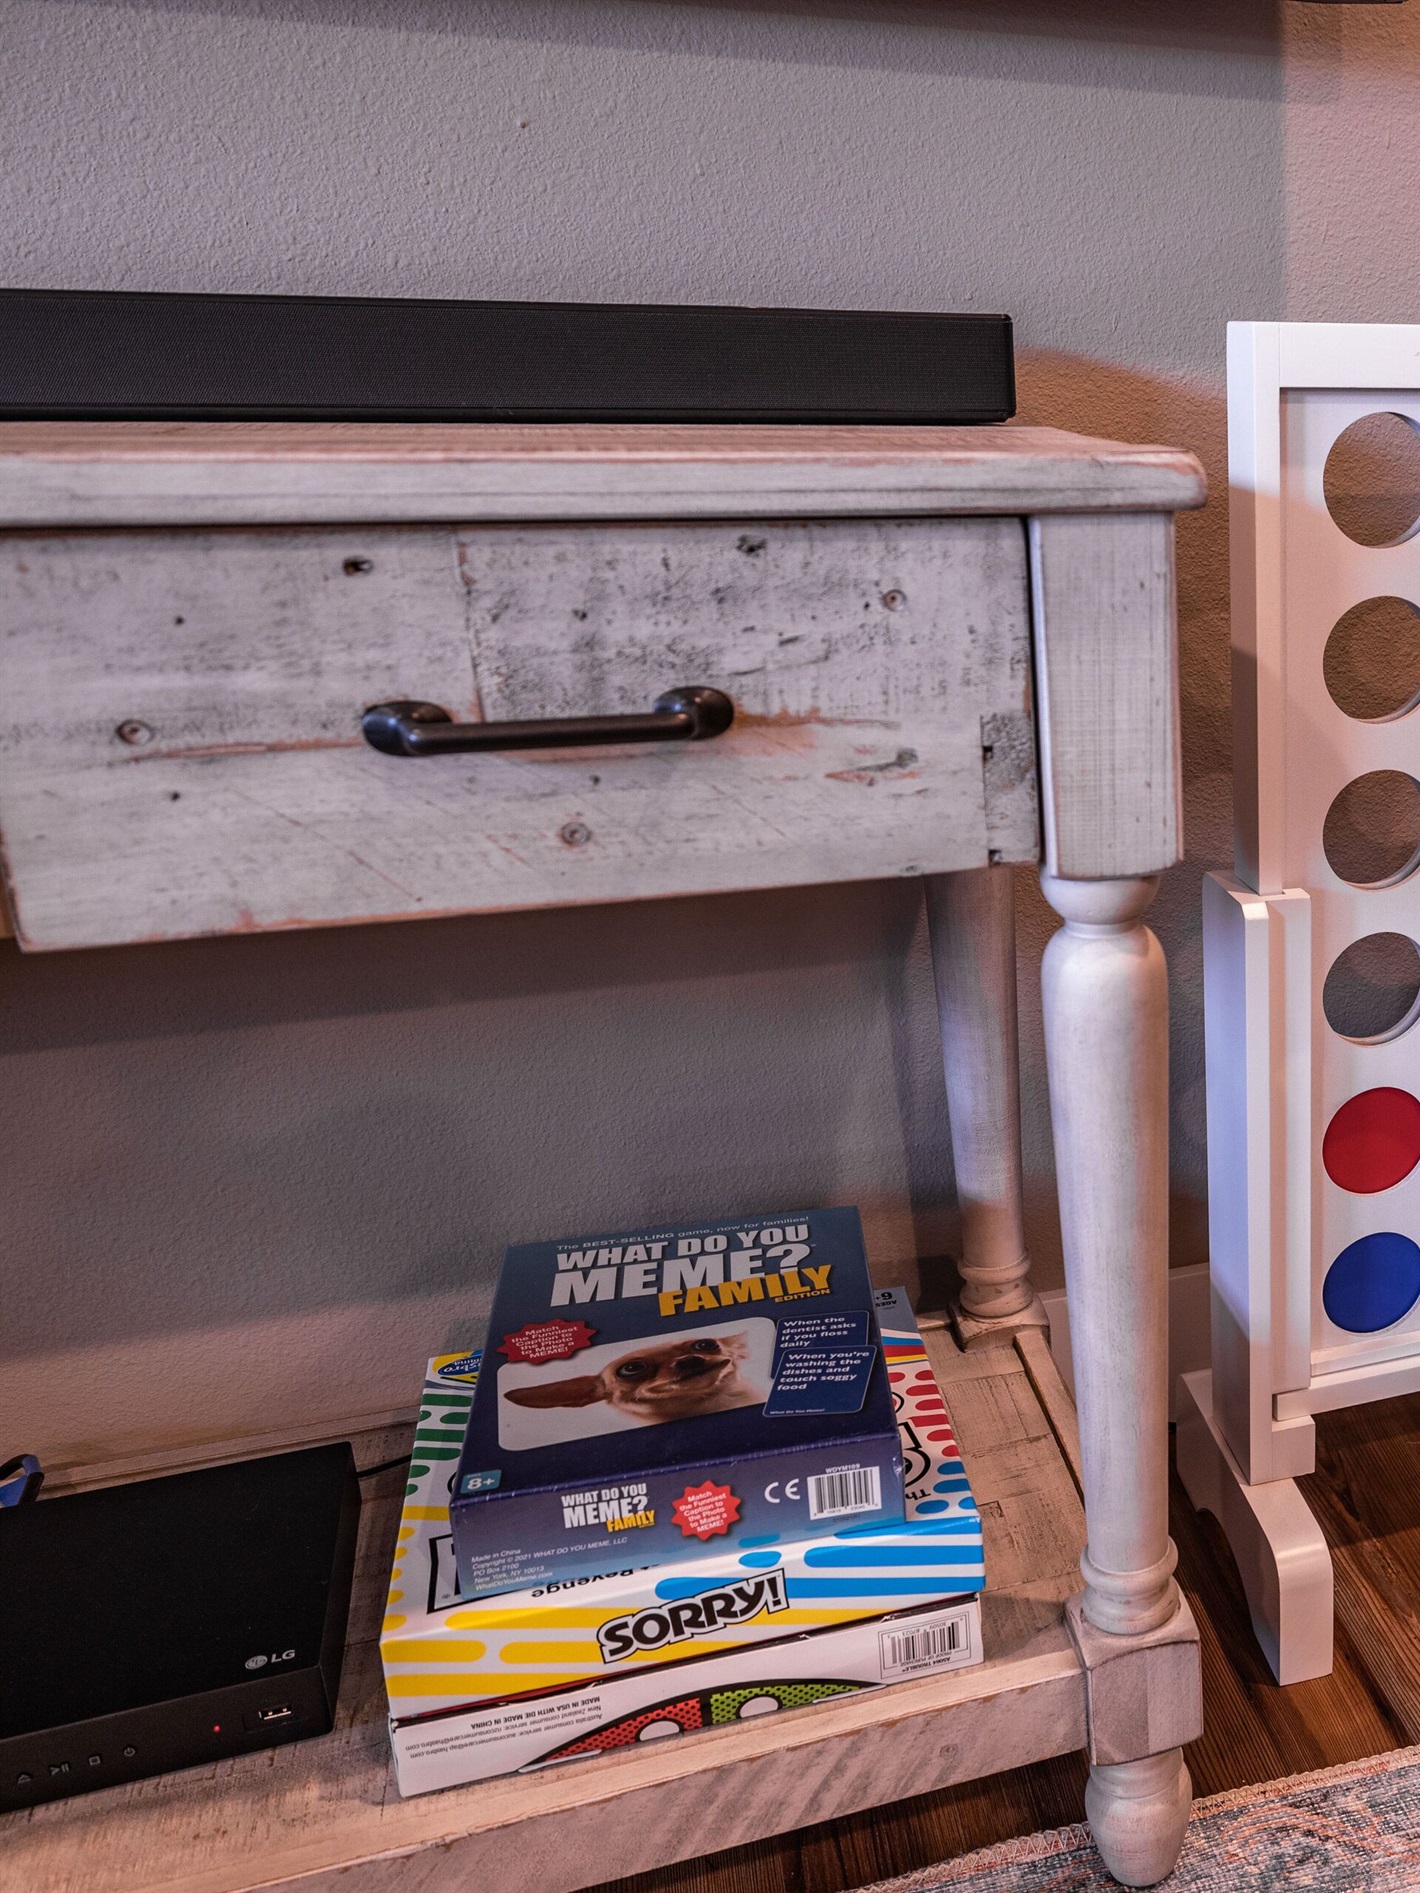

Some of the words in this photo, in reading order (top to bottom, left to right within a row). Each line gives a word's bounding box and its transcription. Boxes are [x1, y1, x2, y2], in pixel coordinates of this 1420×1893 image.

[583, 1232, 674, 1247] BEST-SELLING
[678, 1228, 713, 1238] game,
[763, 1216, 809, 1227] families!
[557, 1241, 668, 1270] WHAT
[677, 1234, 728, 1256] DO
[736, 1224, 809, 1248] YOU
[550, 1244, 811, 1307] MEME?
[658, 1264, 832, 1317] FAMILY
[775, 1288, 831, 1303] EDITION
[783, 1319, 820, 1327] When
[525, 1326, 559, 1336] Match
[532, 1326, 578, 1339] Funniest
[782, 1325, 827, 1334] dentist
[516, 1334, 558, 1347] Caption
[794, 1333, 817, 1341] you
[521, 1343, 538, 1351] the
[541, 1337, 573, 1346] Photo
[535, 1343, 565, 1352] Make
[780, 1340, 811, 1348] daily
[529, 1347, 568, 1358] MEME!
[788, 1352, 826, 1360] When
[829, 1351, 870, 1359] you're
[782, 1367, 822, 1375] dishes
[780, 1375, 817, 1383] touch
[820, 1374, 857, 1382] soggy
[777, 1383, 807, 1391] food
[467, 1477, 495, 1490] 8+
[561, 1490, 599, 1507] WHAT
[601, 1487, 619, 1501] DO
[621, 1483, 647, 1497] YOU
[687, 1491, 712, 1502] Match
[905, 1489, 931, 1500] Th
[679, 1504, 693, 1512] the
[693, 1493, 727, 1507] Funniest
[562, 1495, 648, 1529] MEME?
[683, 1504, 714, 1517] Caption
[702, 1507, 725, 1517] Photo
[606, 1509, 655, 1532] FAMILY
[696, 1519, 724, 1532] MEME!
[700, 1515, 720, 1525] Make
[471, 1554, 491, 1562] Made
[500, 1549, 521, 1557] China
[472, 1559, 506, 1570] Copyright
[514, 1553, 531, 1561] 2021
[533, 1549, 555, 1558] WHAT
[570, 1544, 586, 1552] YOU
[501, 1563, 519, 1571] 2100
[523, 1565, 544, 1574] 10013
[601, 1573, 785, 1659] SORRY!
[270, 1649, 296, 1663] LG
[581, 1696, 600, 1705] MADE
[537, 1707, 555, 1716] WITH
[556, 1703, 571, 1711] USA
[561, 1708, 585, 1717] Zealand
[503, 1714, 523, 1723] MADE
[529, 1715, 560, 1726] consumer
[576, 1713, 602, 1723] Australia
[471, 1720, 492, 1729] CHINA
[544, 1720, 574, 1729] consumer
